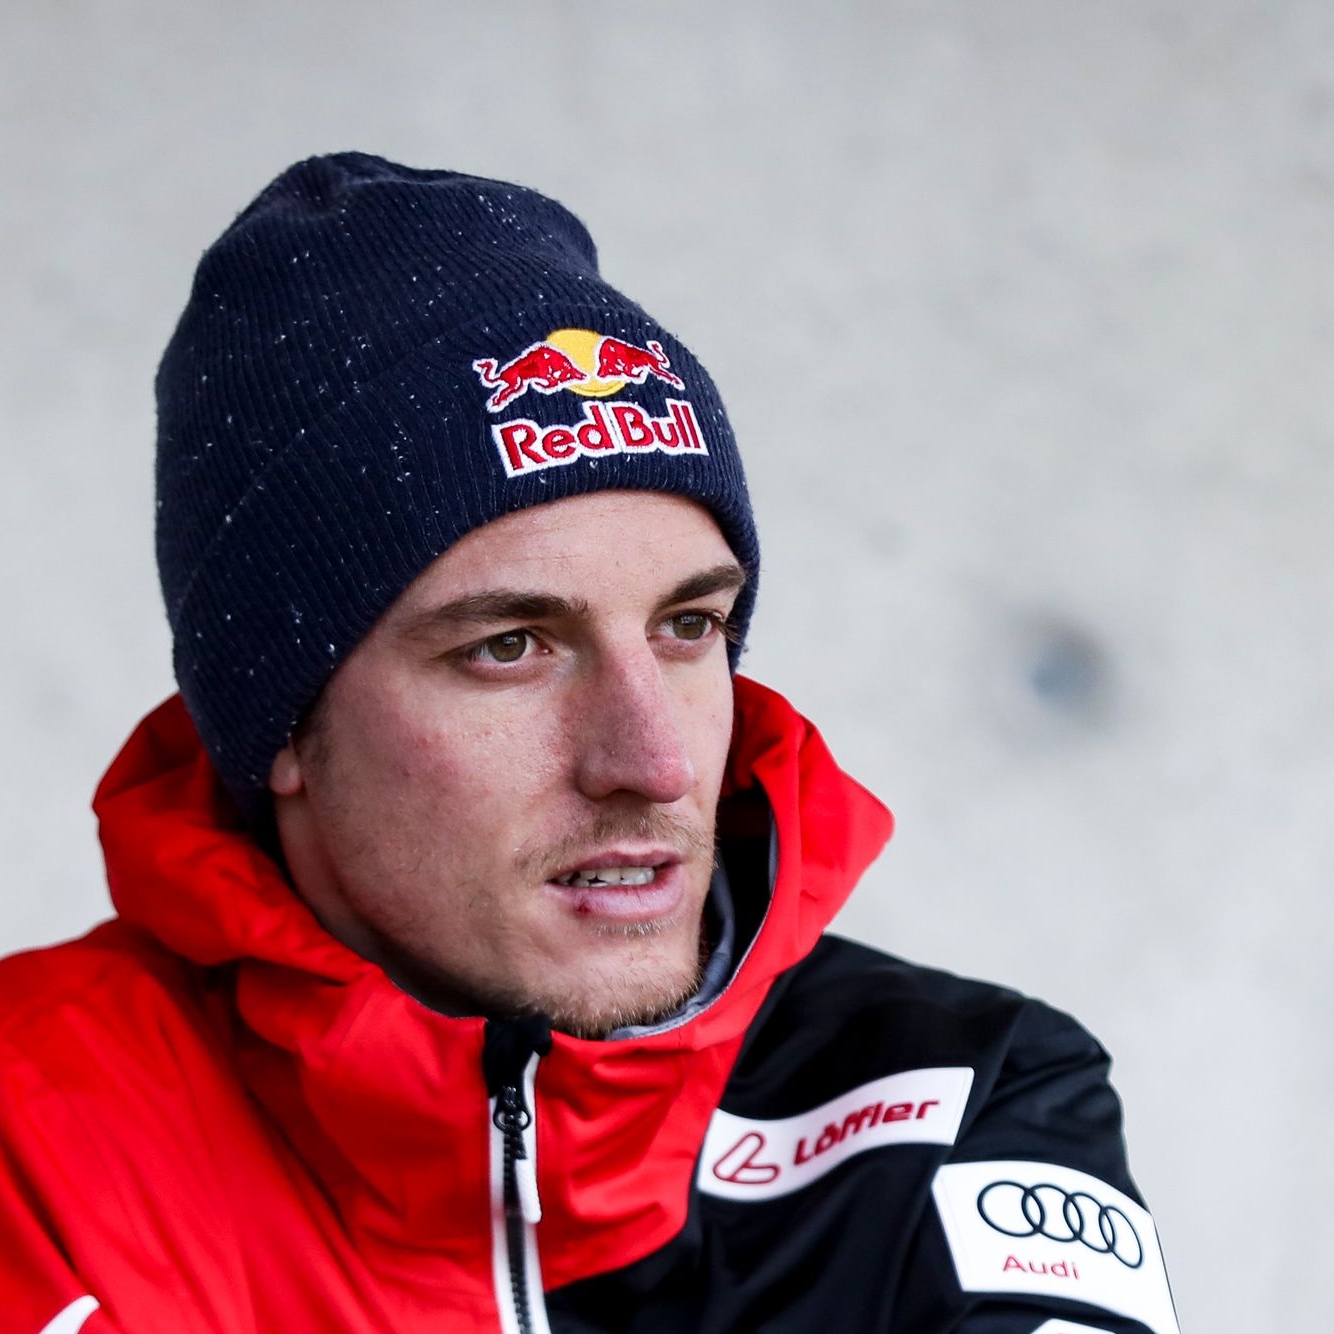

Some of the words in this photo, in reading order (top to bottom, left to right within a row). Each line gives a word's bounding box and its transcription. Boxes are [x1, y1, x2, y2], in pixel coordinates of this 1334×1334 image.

[499, 404, 615, 471] Red
[611, 403, 701, 449] Bull
[1002, 1255, 1079, 1279] Audi
